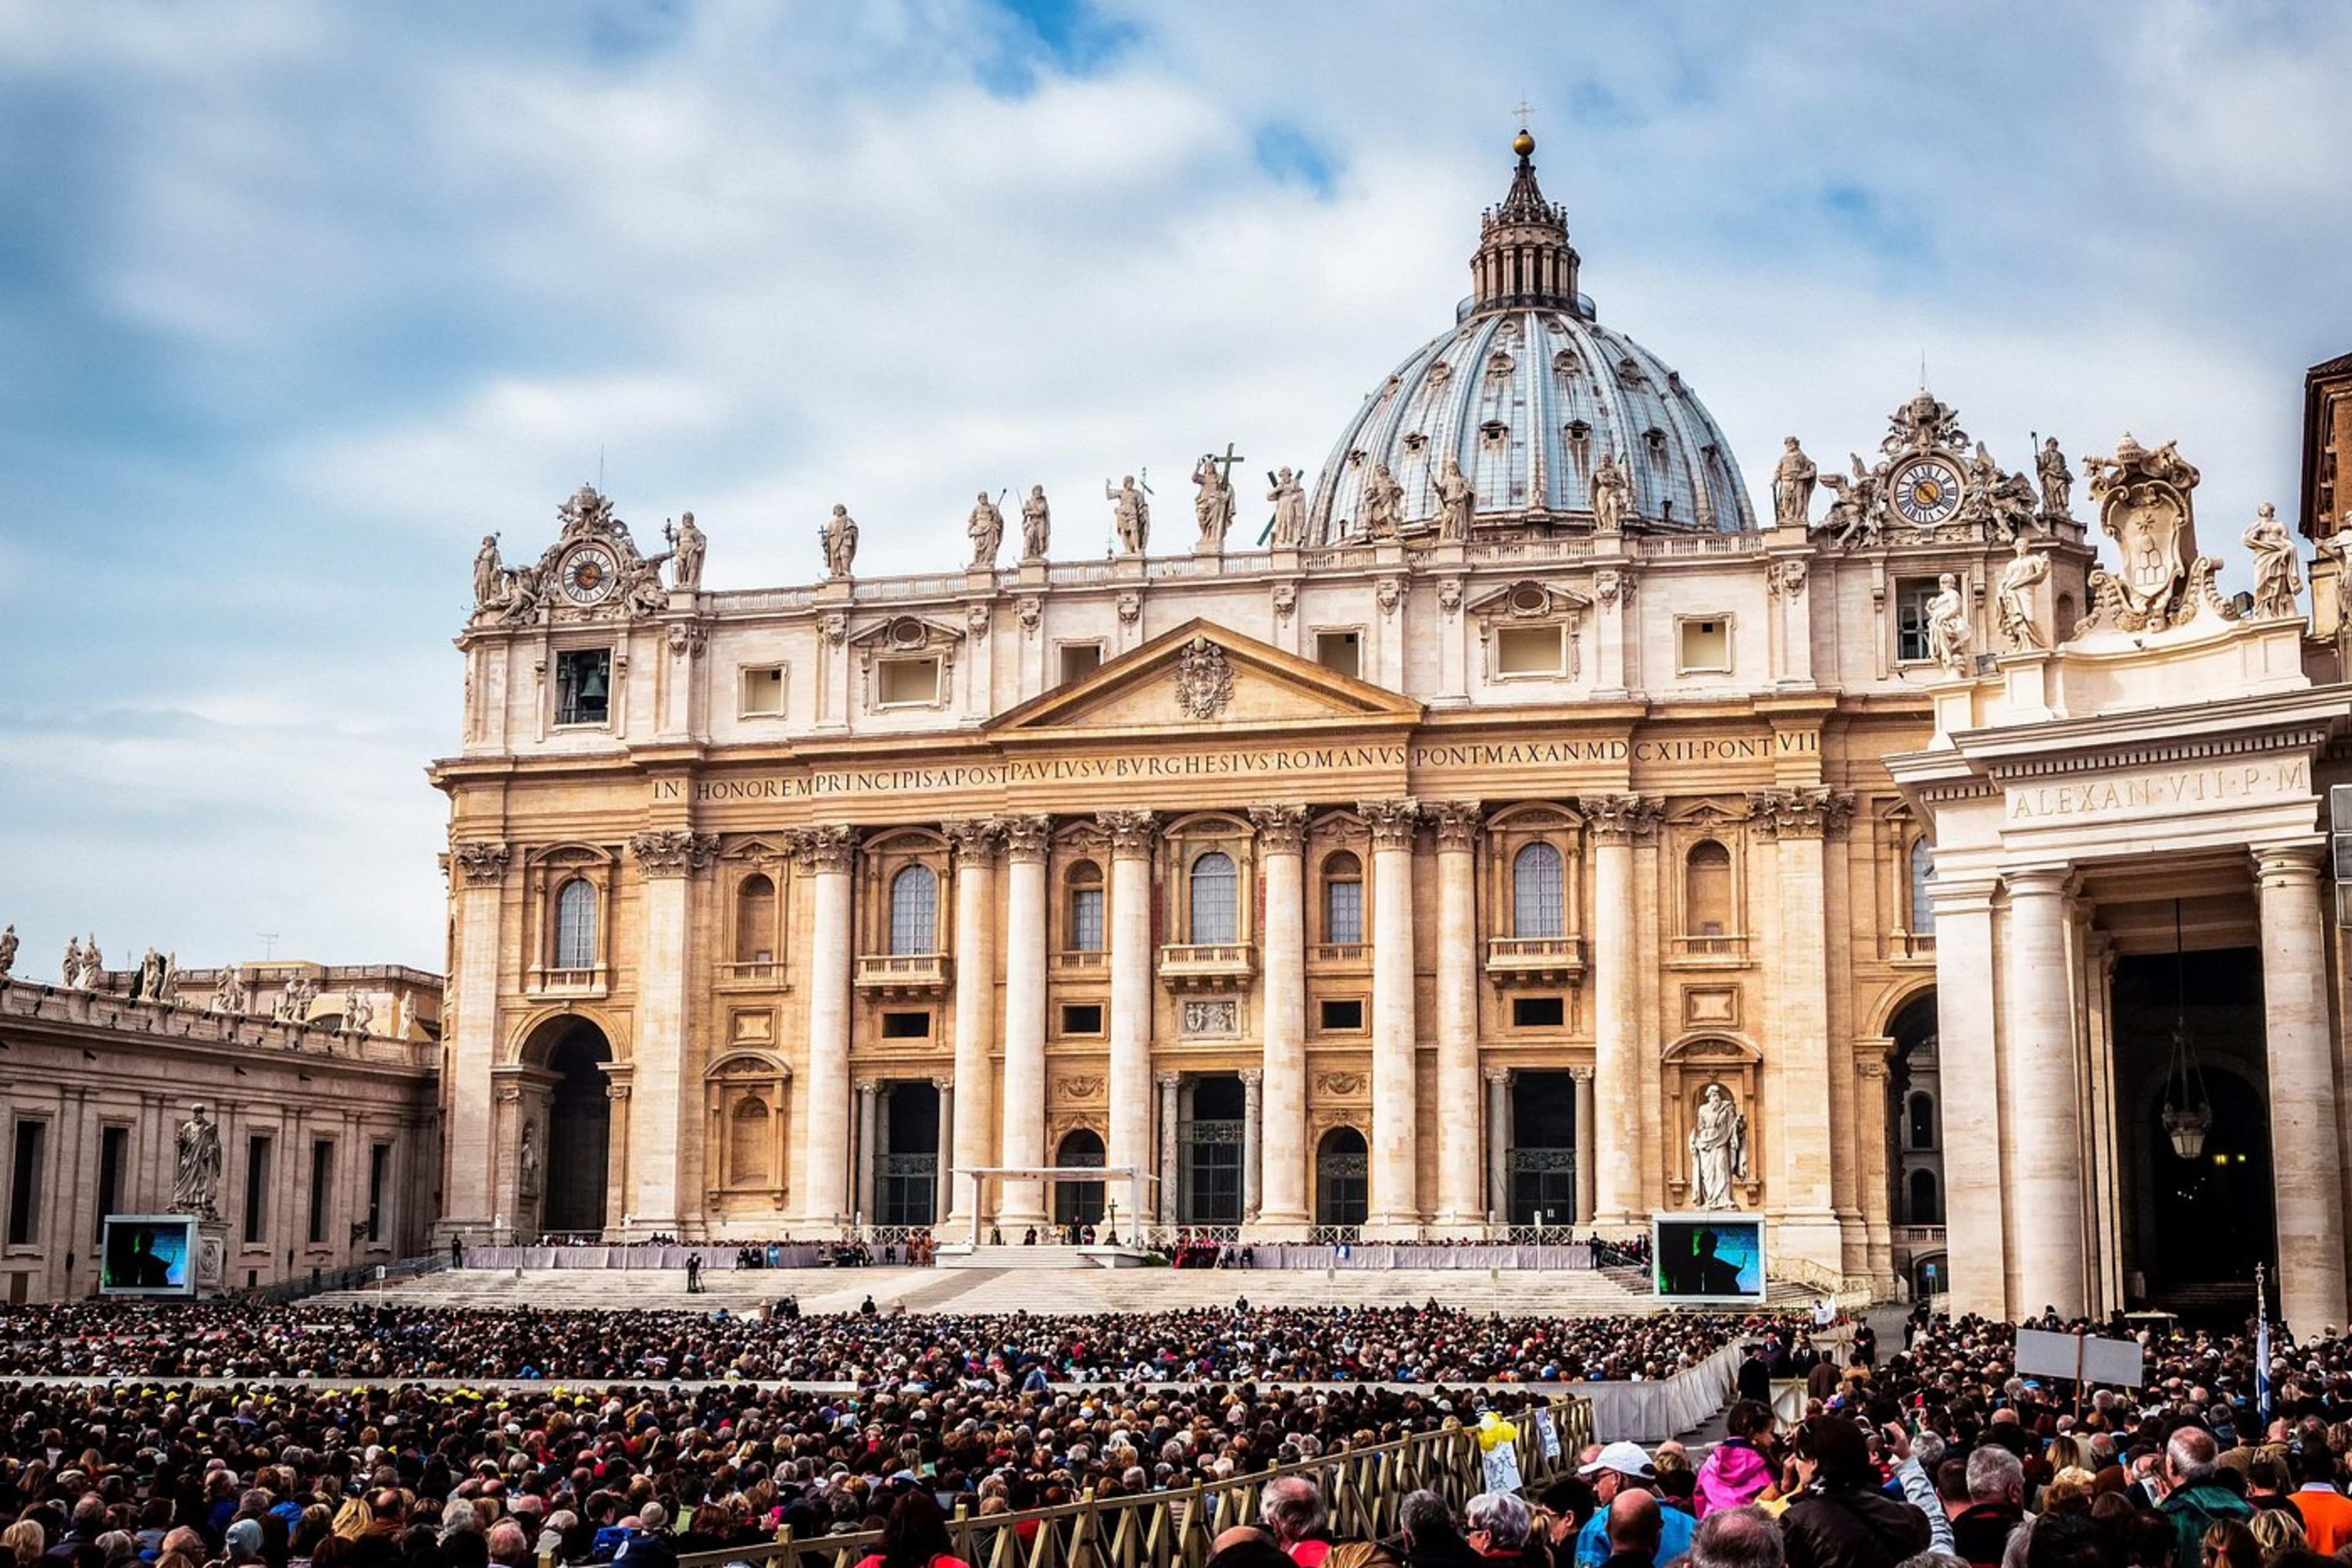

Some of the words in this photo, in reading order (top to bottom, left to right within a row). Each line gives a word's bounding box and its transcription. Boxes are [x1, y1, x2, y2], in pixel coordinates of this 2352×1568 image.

[654, 780, 679, 798] IN
[696, 778, 812, 800] HONOREM
[815, 769, 932, 792] PRINCIPIS
[937, 766, 1009, 786] APOST
[1011, 760, 1090, 780] PAVLVS
[1117, 752, 1268, 777] BVRGHESIVS
[1276, 746, 1405, 770] ROMANVS
[1702, 737, 1774, 758] PONT
[1779, 733, 1817, 752] VII
[2011, 778, 2152, 820] ALEXAN
[2165, 771, 2225, 802] VII
